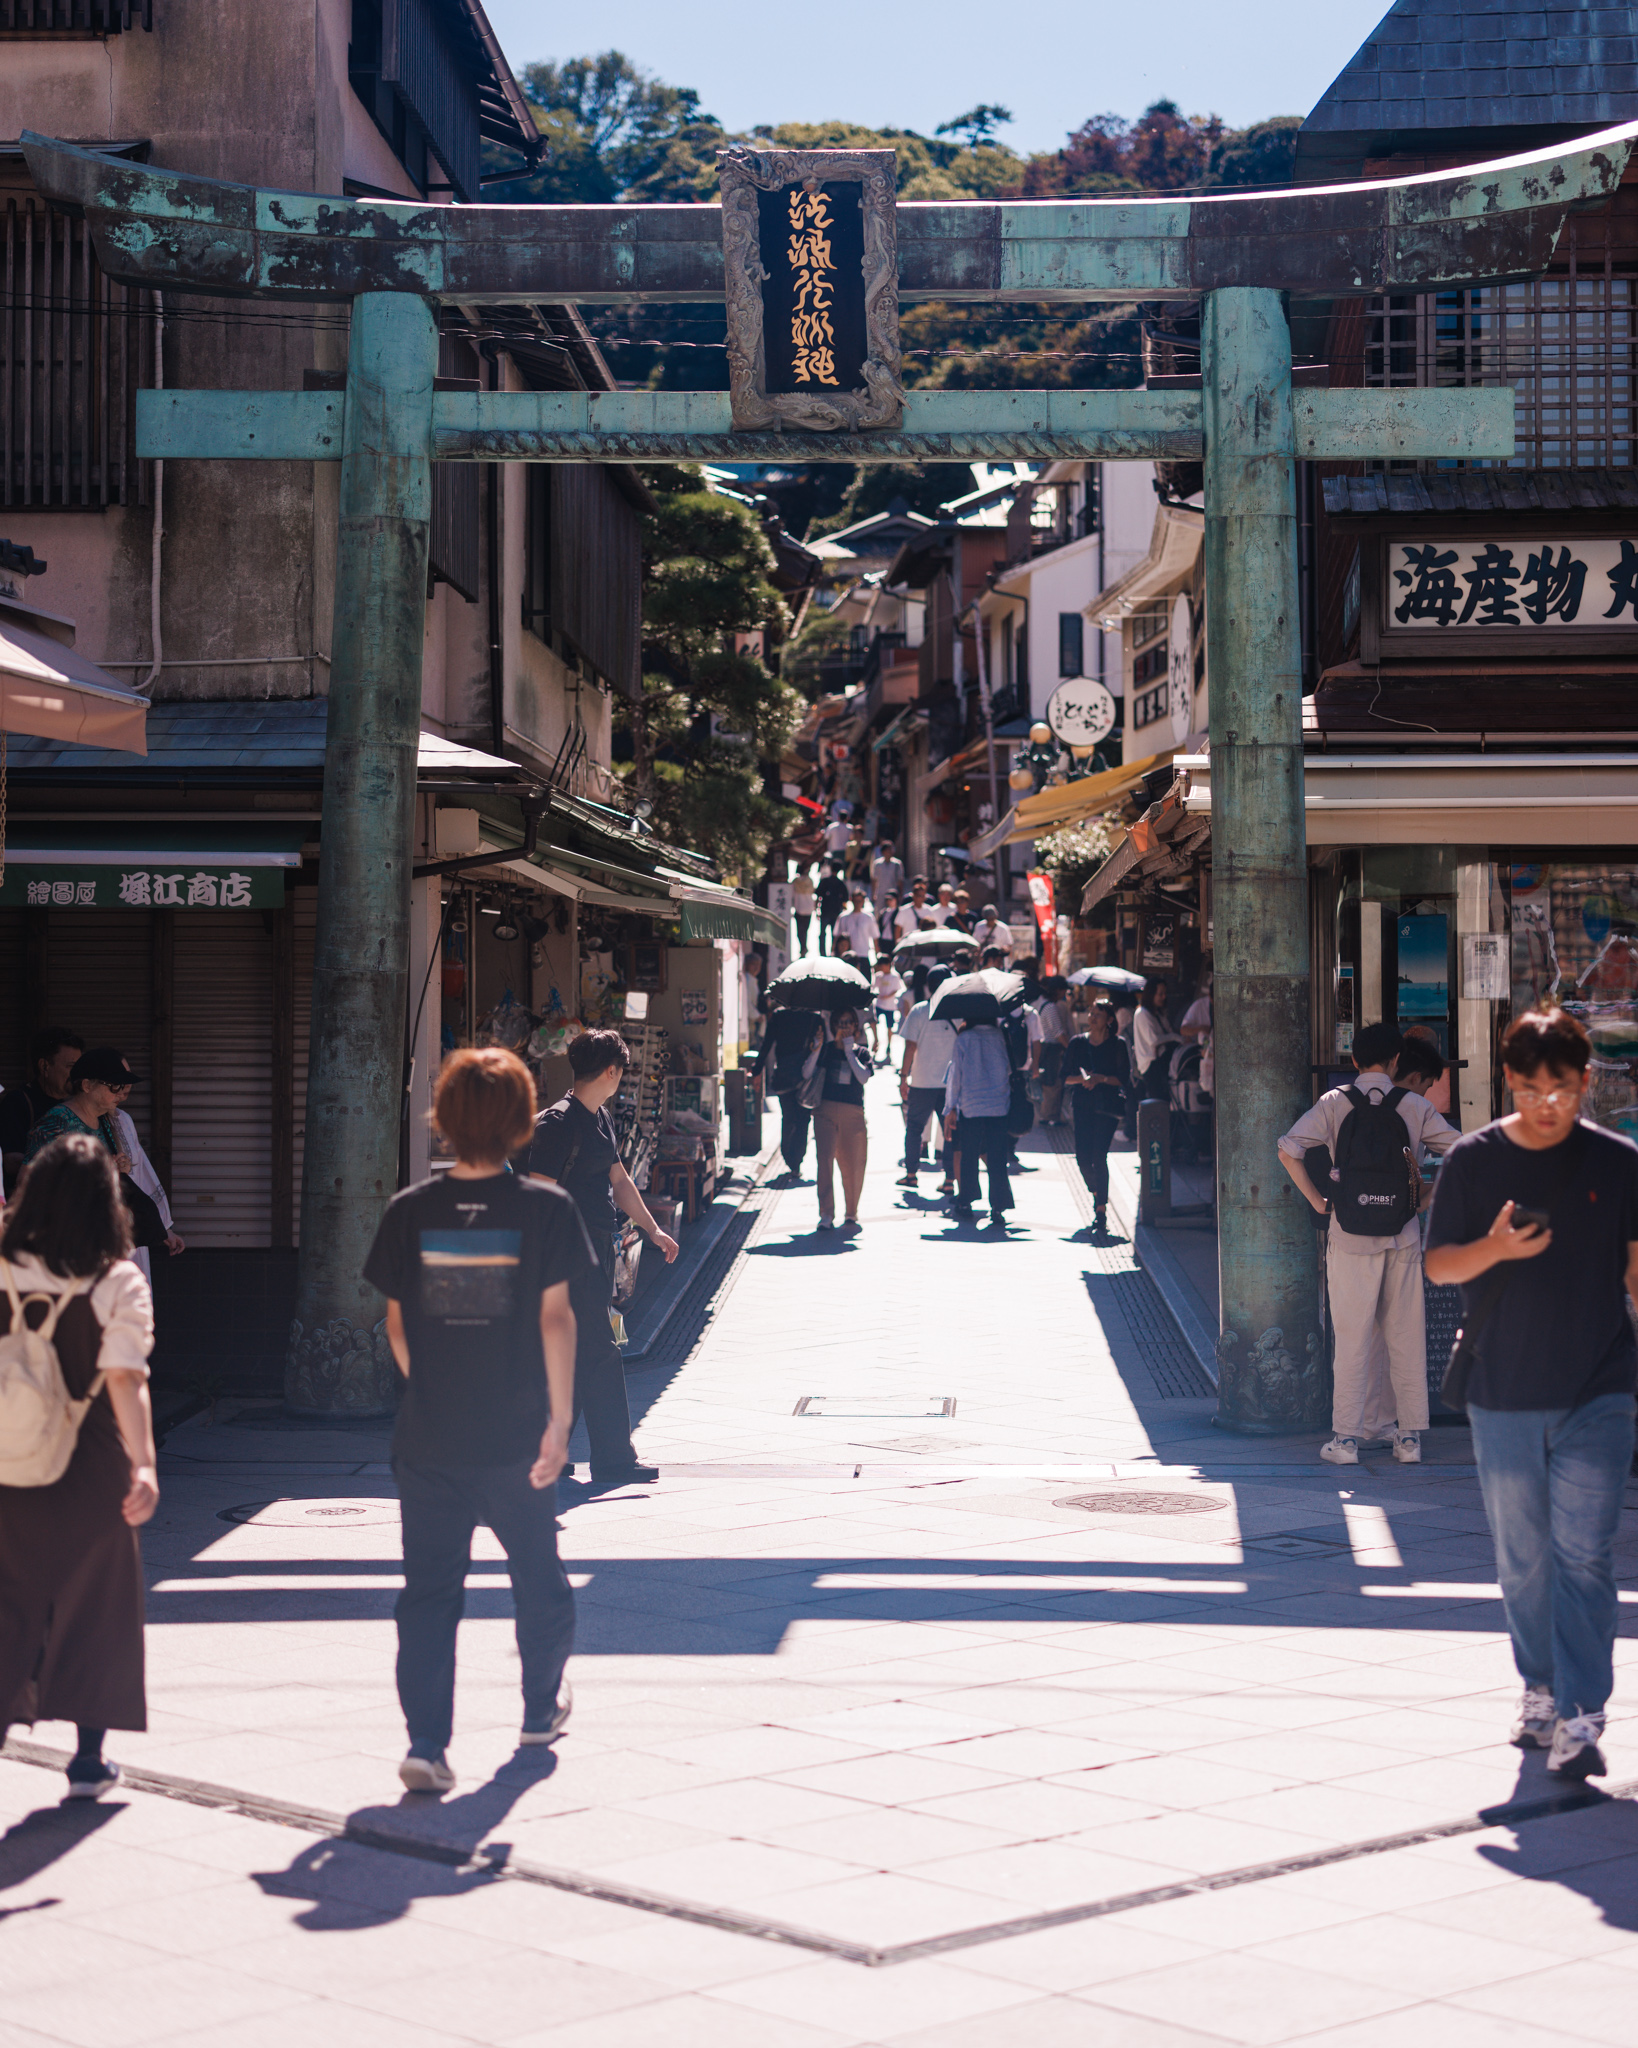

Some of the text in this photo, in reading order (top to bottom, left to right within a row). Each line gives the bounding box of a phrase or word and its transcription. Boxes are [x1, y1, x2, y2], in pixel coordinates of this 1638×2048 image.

[1393, 543, 1588, 626] 海産物
[118, 871, 253, 907] 堀江商店
